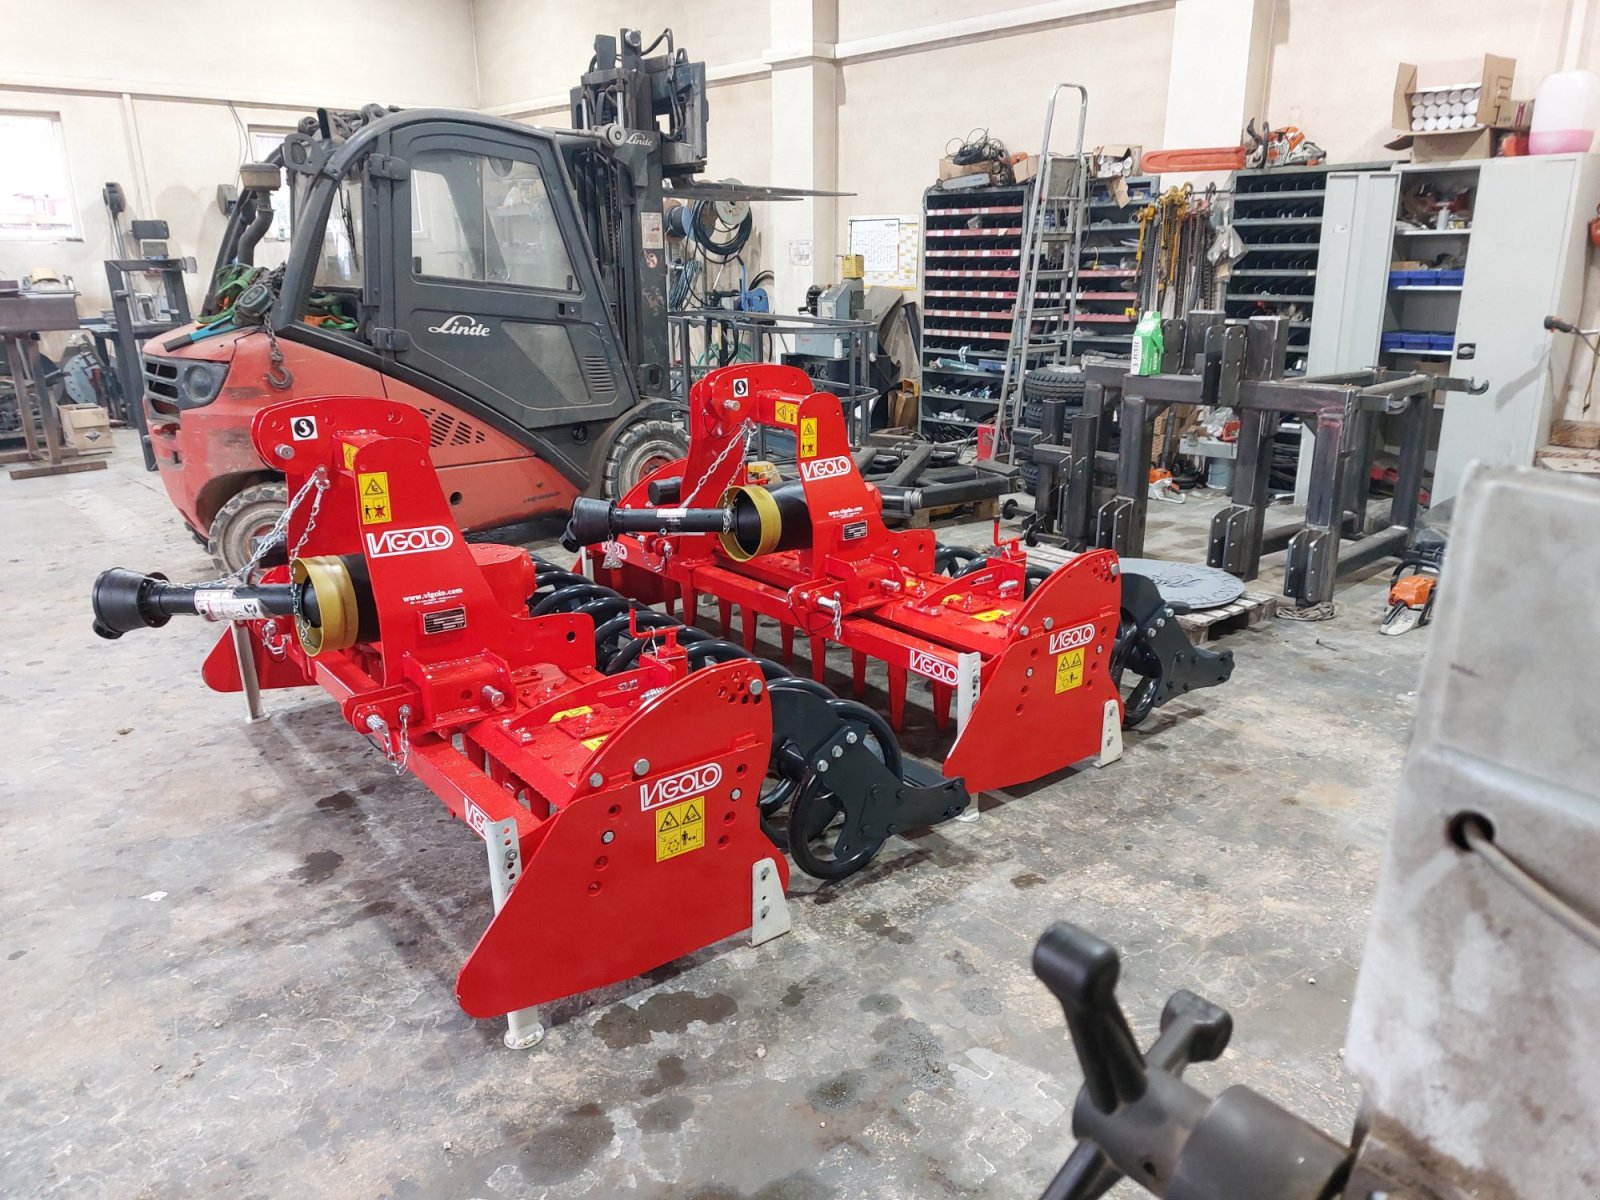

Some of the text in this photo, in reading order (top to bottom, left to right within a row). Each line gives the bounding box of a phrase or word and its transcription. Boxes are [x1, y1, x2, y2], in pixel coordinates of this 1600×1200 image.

[626, 132, 653, 146] Linde
[427, 314, 491, 337] Linde
[800, 456, 852, 482] VIGOLO
[366, 525, 454, 559] VIGOLO
[402, 588, 463, 602] www.vigolo.com
[1049, 623, 1096, 655] VIGOLO
[910, 649, 959, 686] VIGOLO
[640, 762, 723, 812] VIGOLO
[464, 797, 488, 840] VIG
